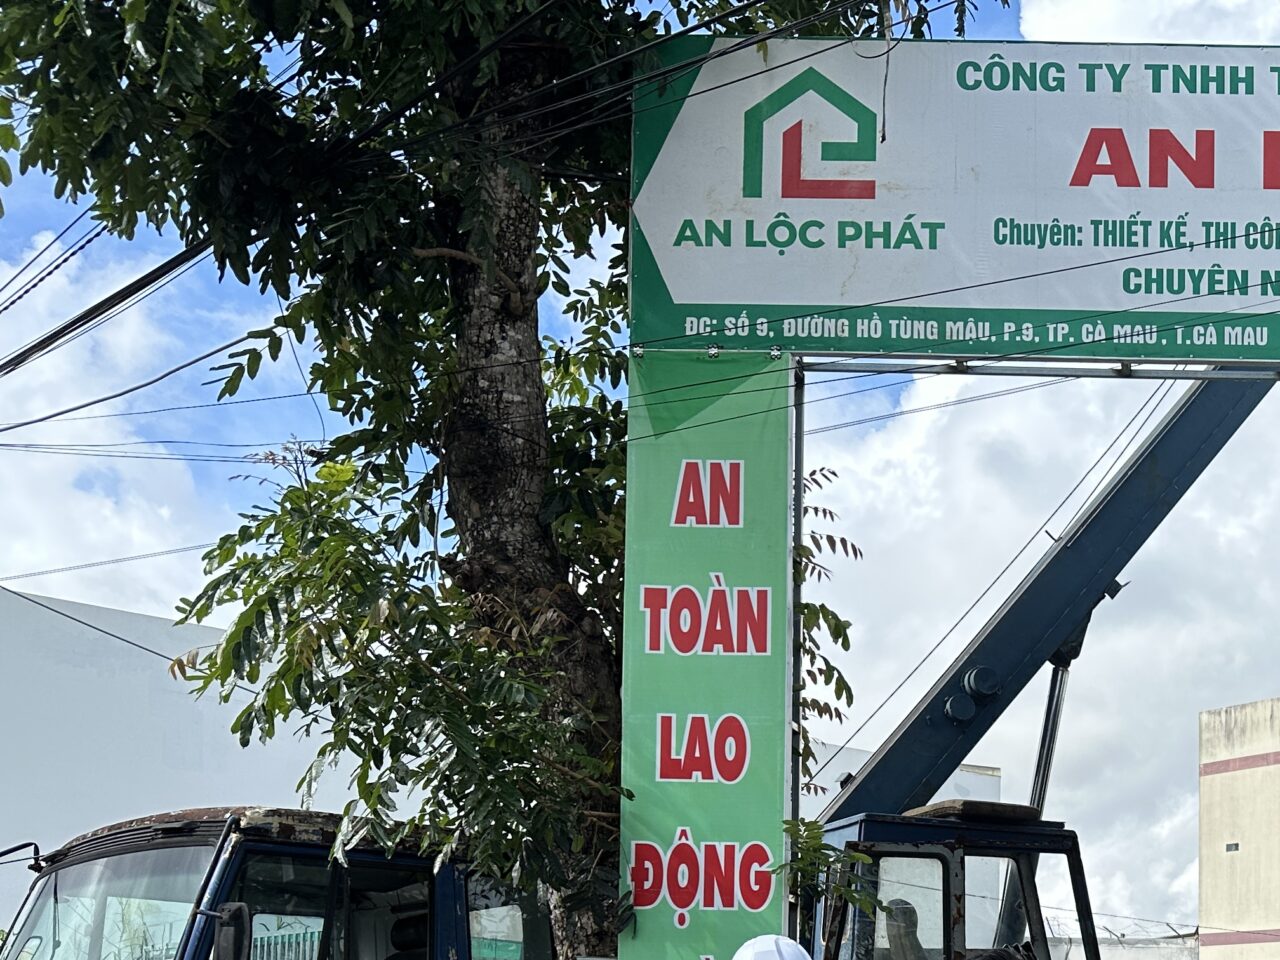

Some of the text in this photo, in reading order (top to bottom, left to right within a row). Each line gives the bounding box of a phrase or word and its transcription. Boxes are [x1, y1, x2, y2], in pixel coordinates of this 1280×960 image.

[956, 53, 1066, 93] CÔNG
[1078, 63, 1131, 93] TY
[1144, 63, 1255, 95] TNHH
[1068, 127, 1215, 189] AN
[672, 211, 946, 256] AN LỘC PHÁT
[993, 217, 1083, 249] Chuyên:
[1090, 211, 1153, 248] THIẾT
[1159, 211, 1195, 252] KẾ,
[1201, 220, 1237, 250] THI
[1122, 263, 1249, 296] CHUYÊN
[724, 310, 750, 338] SỐ
[782, 314, 850, 338] ĐƯỜNG
[856, 311, 882, 339] HỒ
[888, 314, 938, 341] TÙNG
[945, 317, 997, 344] MẬU,
[1003, 322, 1040, 344] P.9,
[1046, 322, 1075, 343] TP.
[1081, 320, 1107, 343] CÀ
[1223, 326, 1269, 346] MAU
[671, 460, 744, 527] AN
[641, 572, 771, 656] TOÀN
[656, 713, 750, 784] LAO
[630, 826, 775, 929] ĐỘNG
